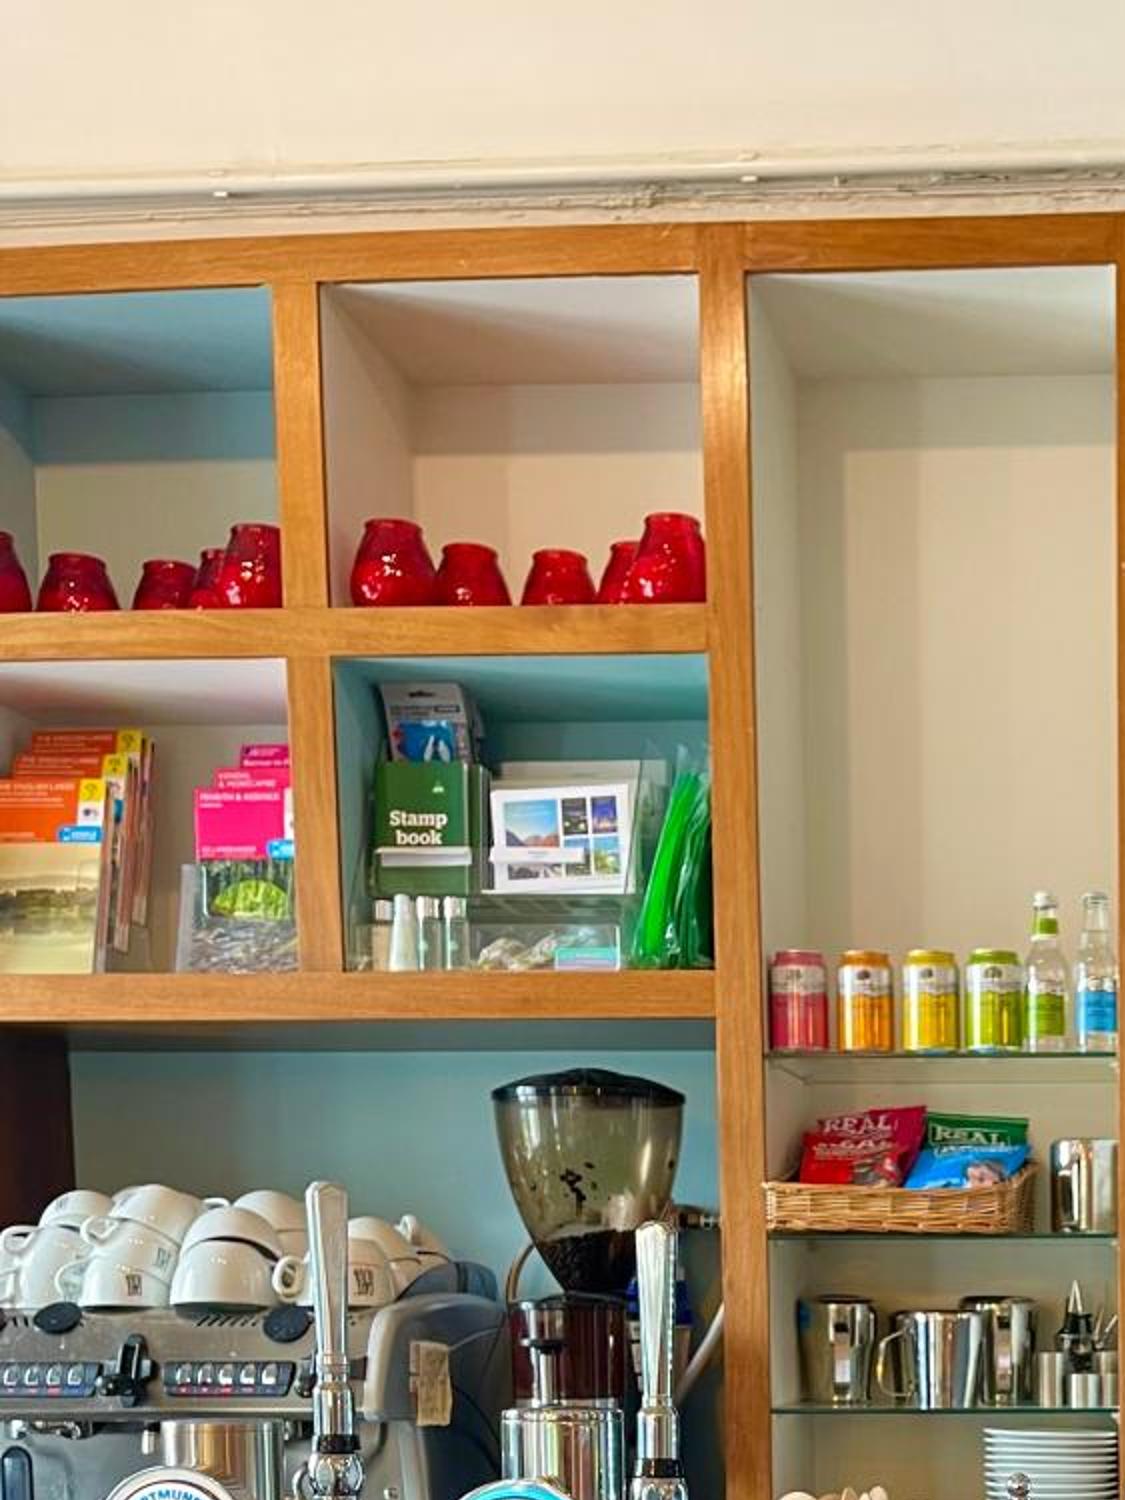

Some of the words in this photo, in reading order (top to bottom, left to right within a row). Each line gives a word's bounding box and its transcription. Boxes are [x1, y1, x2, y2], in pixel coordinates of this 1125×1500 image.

[389, 810, 448, 832] Stamp
[395, 829, 443, 845] book
[823, 1113, 893, 1135] REAL
[935, 1126, 1006, 1146] REAL
